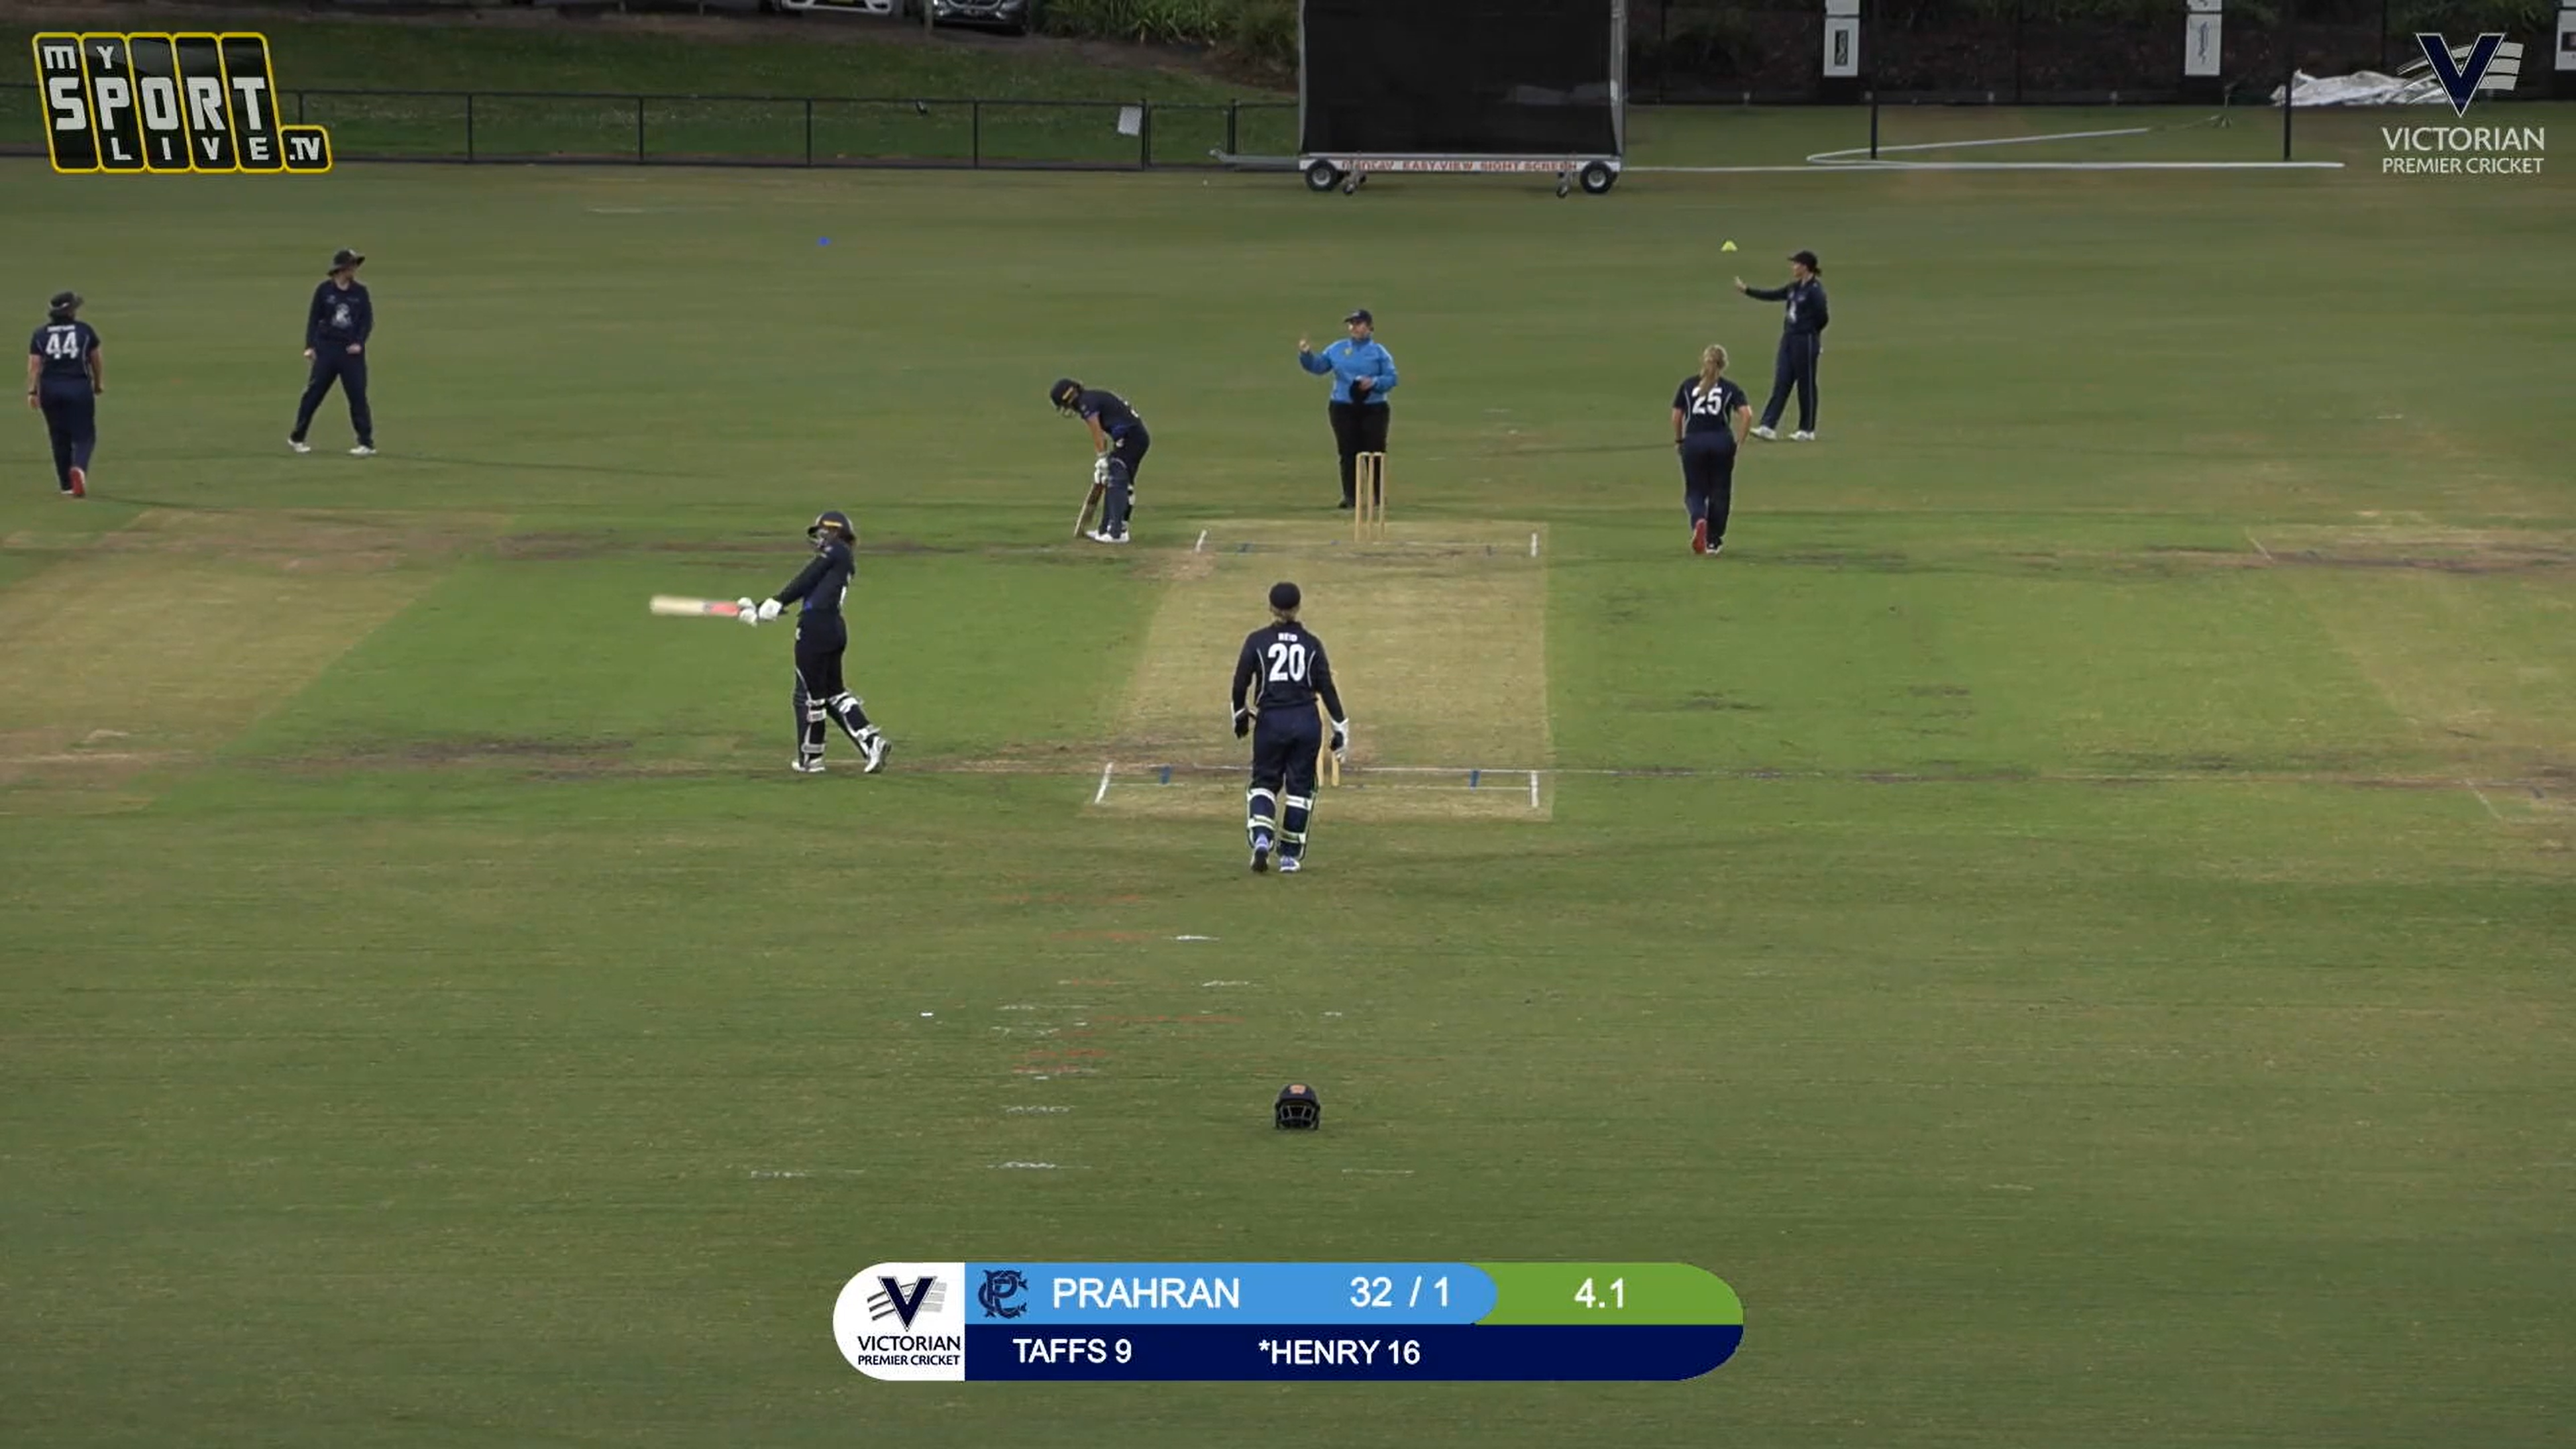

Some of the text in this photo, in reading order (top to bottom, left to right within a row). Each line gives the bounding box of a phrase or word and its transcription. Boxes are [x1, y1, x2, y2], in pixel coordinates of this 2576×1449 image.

[46, 331, 79, 360] 44
[1692, 386, 1722, 415] 25
[1267, 643, 1305, 682] 20
